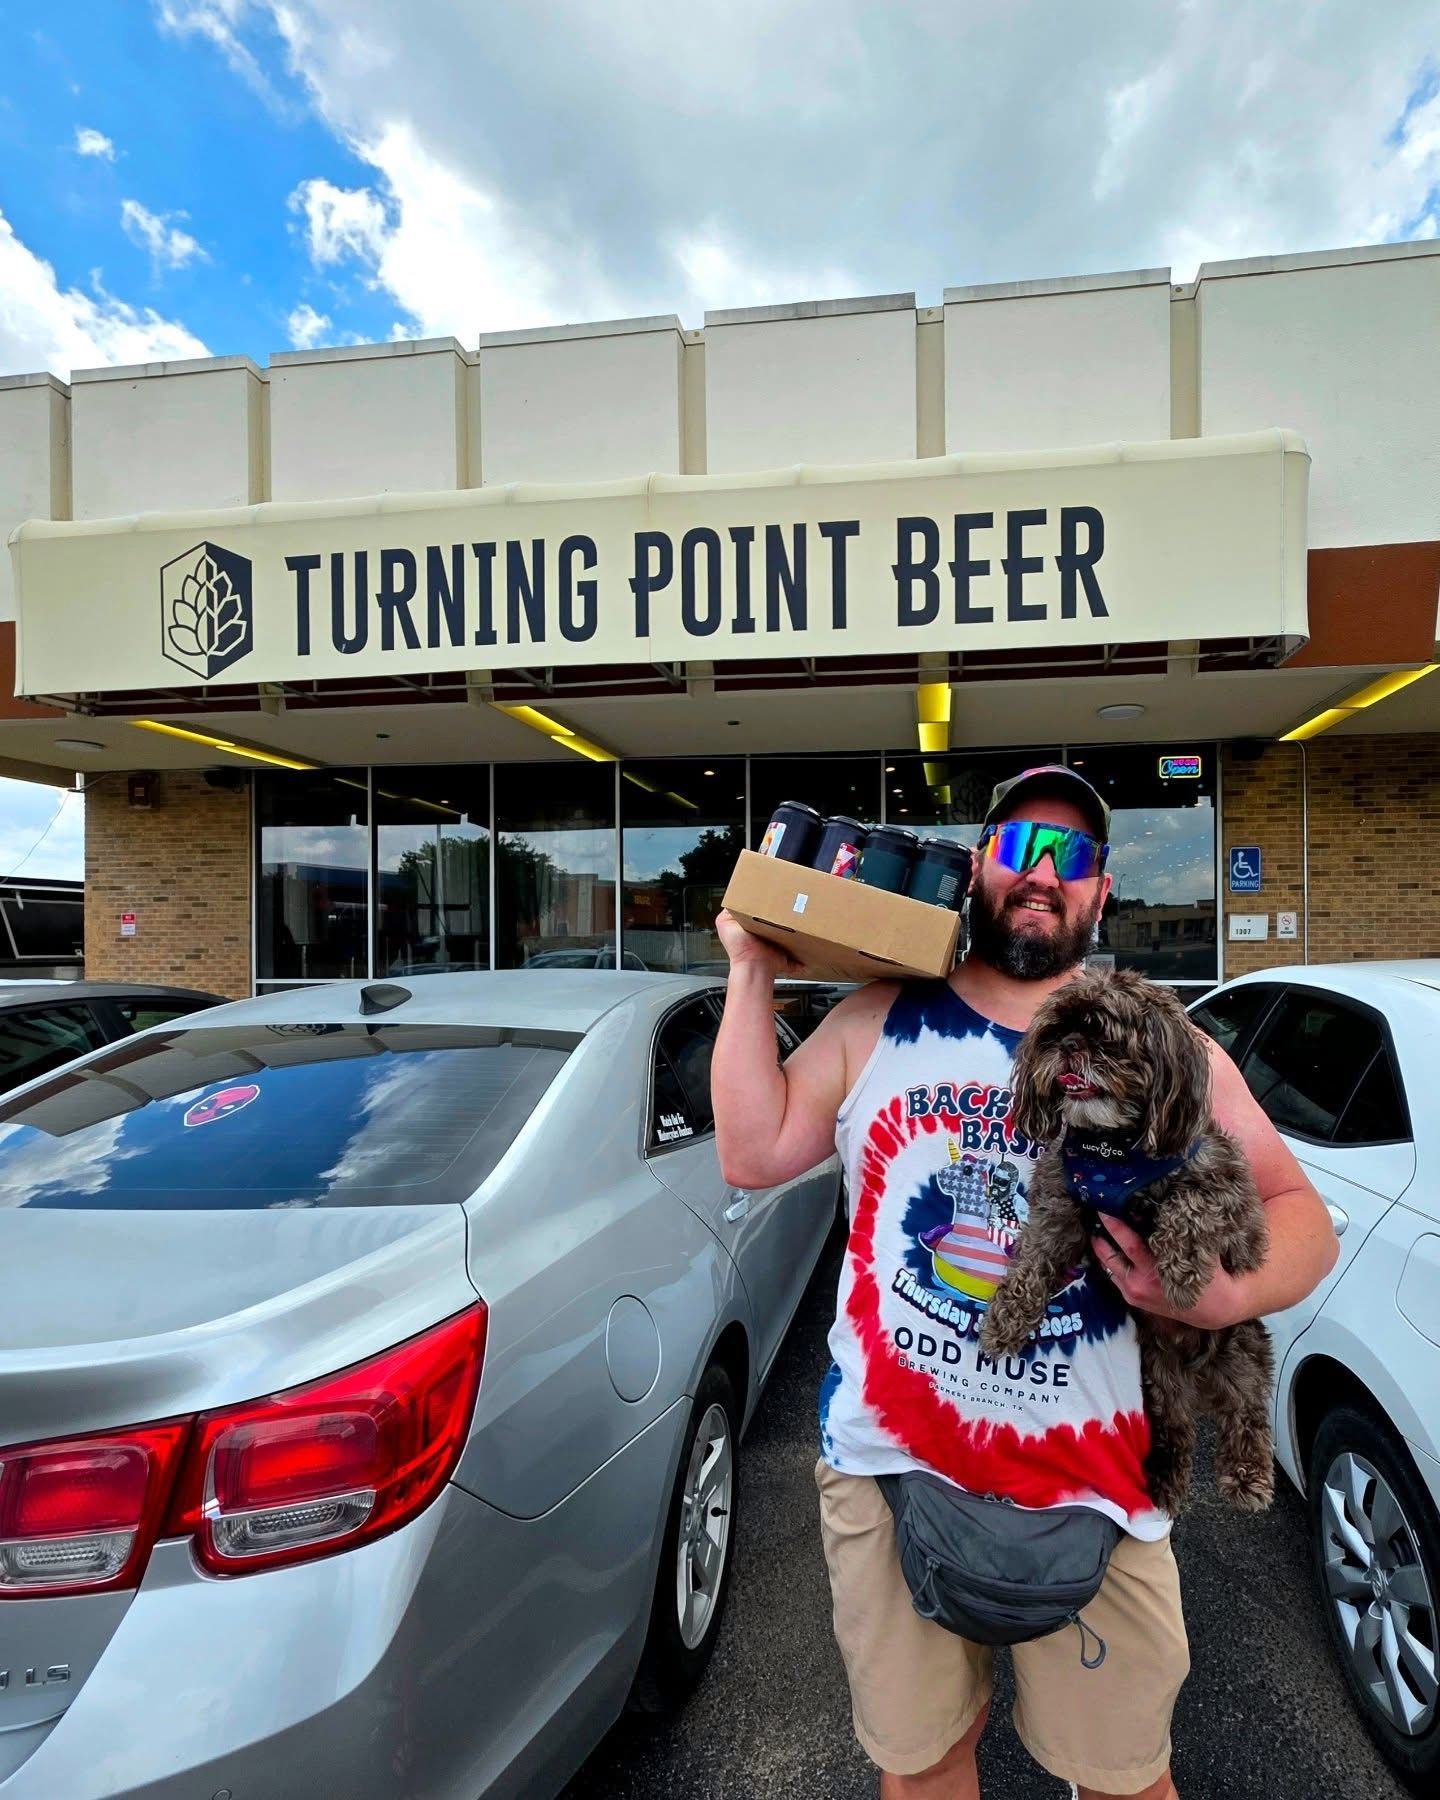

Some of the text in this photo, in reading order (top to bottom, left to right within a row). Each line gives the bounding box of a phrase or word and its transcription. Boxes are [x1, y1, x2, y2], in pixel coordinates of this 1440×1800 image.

[285, 506, 1110, 656] TURNING POINT BEER
[1161, 760, 1199, 778] Open
[1231, 880, 1259, 888] PARKING
[905, 1083, 1015, 1119] BACK
[1082, 1143, 1100, 1152] LUCY
[894, 1269, 972, 1335] Thursday
[1039, 1312, 1084, 1339] 2025
[894, 1326, 1071, 1387] ODD MUSE
[898, 1357, 1061, 1404] BREWING COMPANY
[1012, 1403, 1024, 1411] TX
